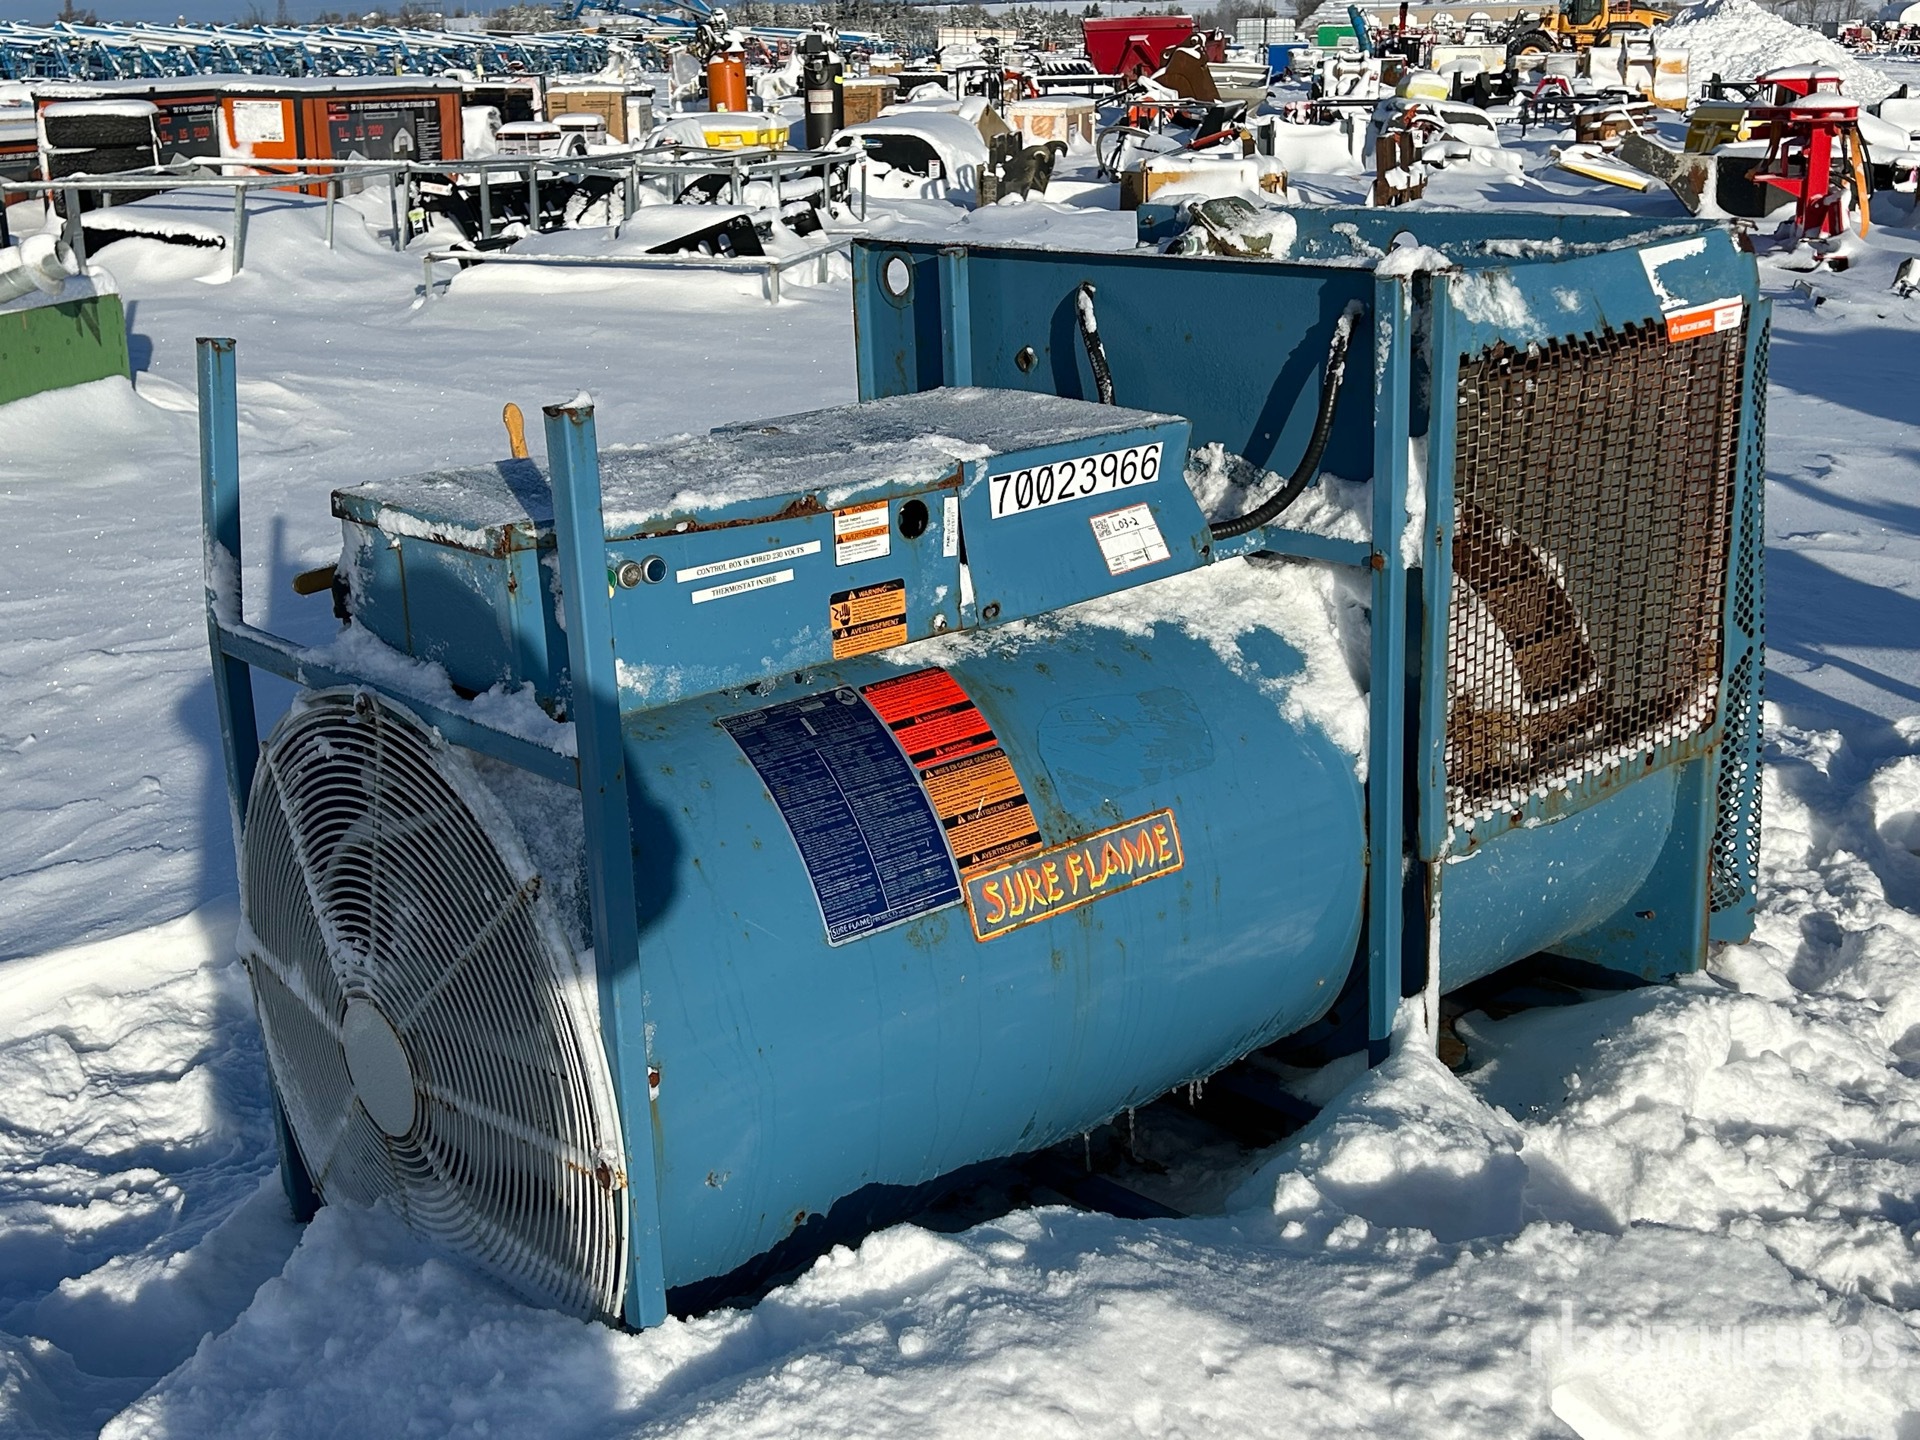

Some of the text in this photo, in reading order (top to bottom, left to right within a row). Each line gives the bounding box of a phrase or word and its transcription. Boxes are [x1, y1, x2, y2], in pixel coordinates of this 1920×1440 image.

[993, 445, 1159, 514] 70023966
[696, 564, 727, 576] CONTROL
[729, 560, 742, 569] BOX
[743, 557, 750, 566] IS
[750, 554, 771, 564] WIRED
[784, 547, 805, 557] VOLTS
[711, 576, 777, 597] THERMOSTAT INSIDE
[850, 618, 900, 636] AVERTISSEMENT
[982, 861, 1064, 924] SURE
[1065, 824, 1173, 895] FLAME
[832, 925, 848, 937] SURE
[848, 917, 871, 931] FLAME
